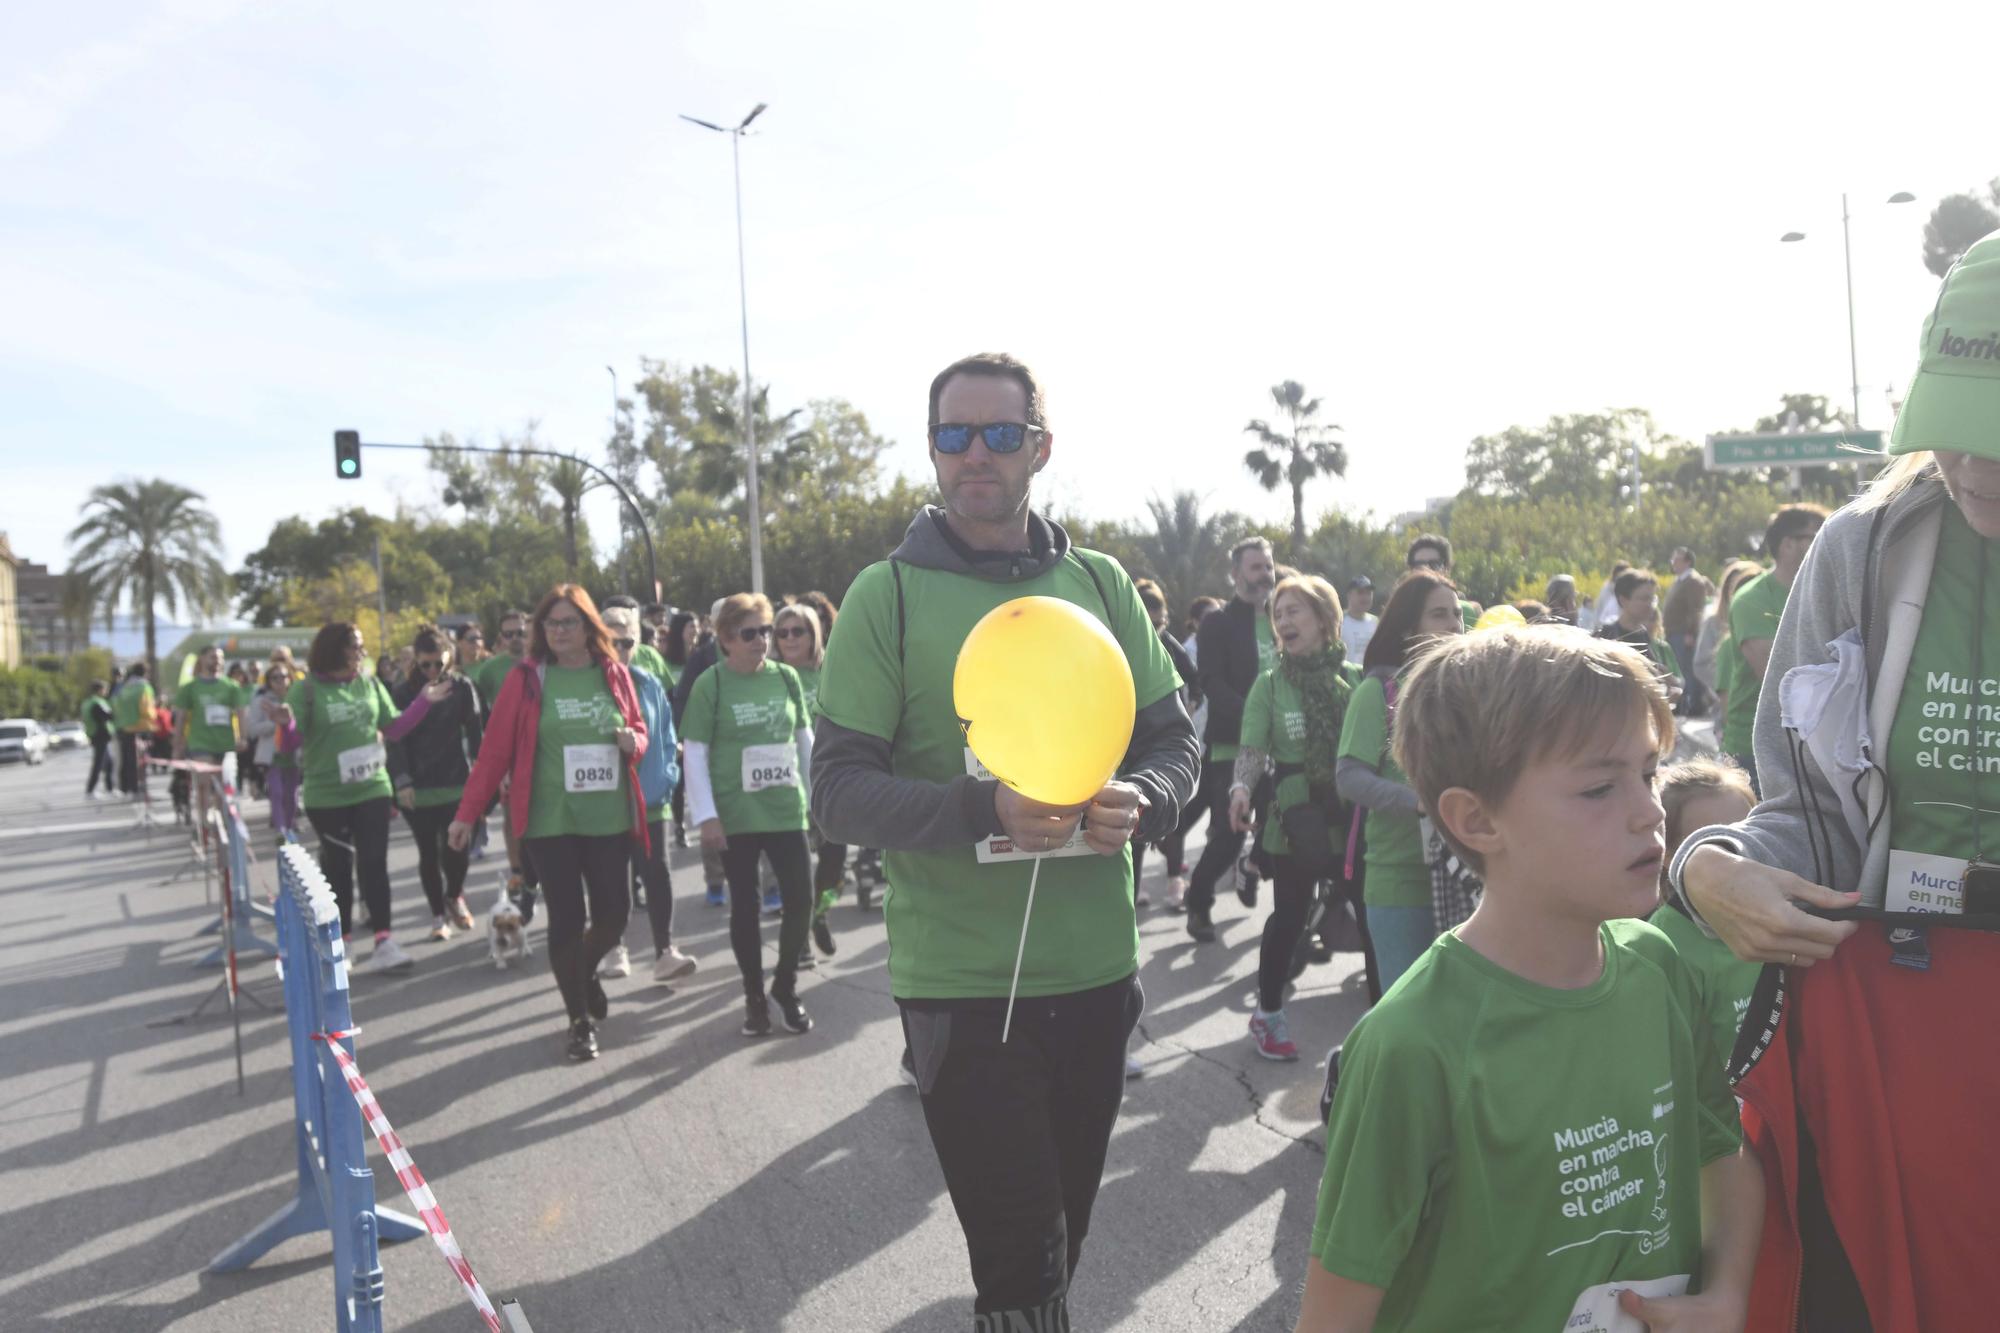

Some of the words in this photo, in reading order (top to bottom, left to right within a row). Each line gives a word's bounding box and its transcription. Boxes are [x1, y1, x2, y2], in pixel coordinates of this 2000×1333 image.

[1922, 701, 1956, 718] en
[1916, 746, 1942, 768] el
[575, 767, 614, 782] 0826
[752, 766, 792, 781] 0824
[1908, 890, 1931, 904] en
[1553, 1116, 1620, 1153] Murcia
[1559, 1154, 1587, 1175] en
[1560, 1165, 1620, 1196] contra
[1562, 1196, 1589, 1218] el
[1592, 1178, 1645, 1214] cáncer
